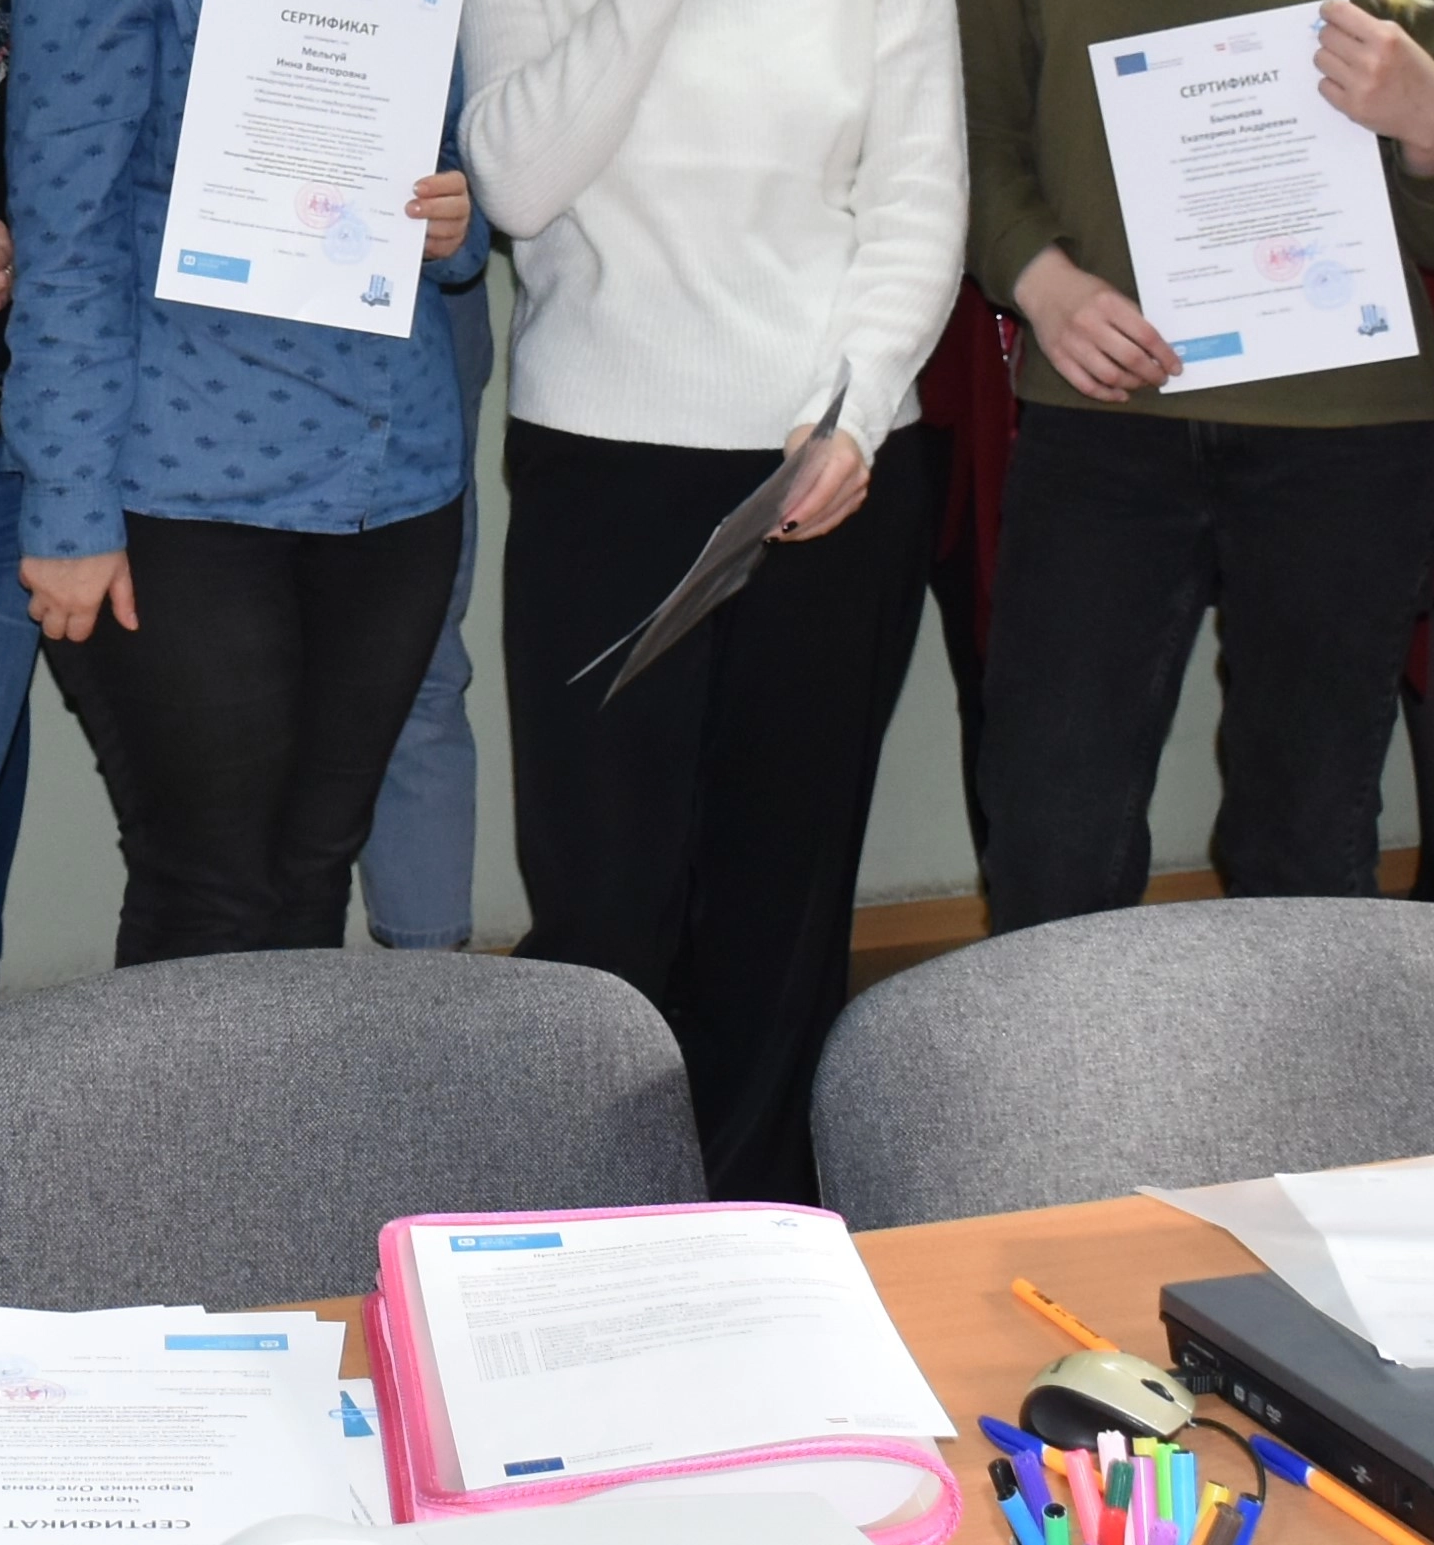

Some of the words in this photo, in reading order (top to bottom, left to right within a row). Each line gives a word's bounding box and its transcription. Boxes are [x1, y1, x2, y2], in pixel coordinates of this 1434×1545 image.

[280, 9, 378, 36] СЕРТИФИКАТ
[301, 47, 347, 62] Мельгуй
[276, 57, 304, 70] Инна
[305, 63, 368, 81] Викторовна
[1179, 69, 1279, 99] СЕРТИФИКАТ
[1238, 117, 1298, 134] Андреевна
[1, 1484, 94, 1492] Олеговна
[99, 1484, 194, 1492] Вероника
[56, 1496, 140, 1504] Черенко
[4, 1519, 191, 1530] СЕРТИФИКАТ
